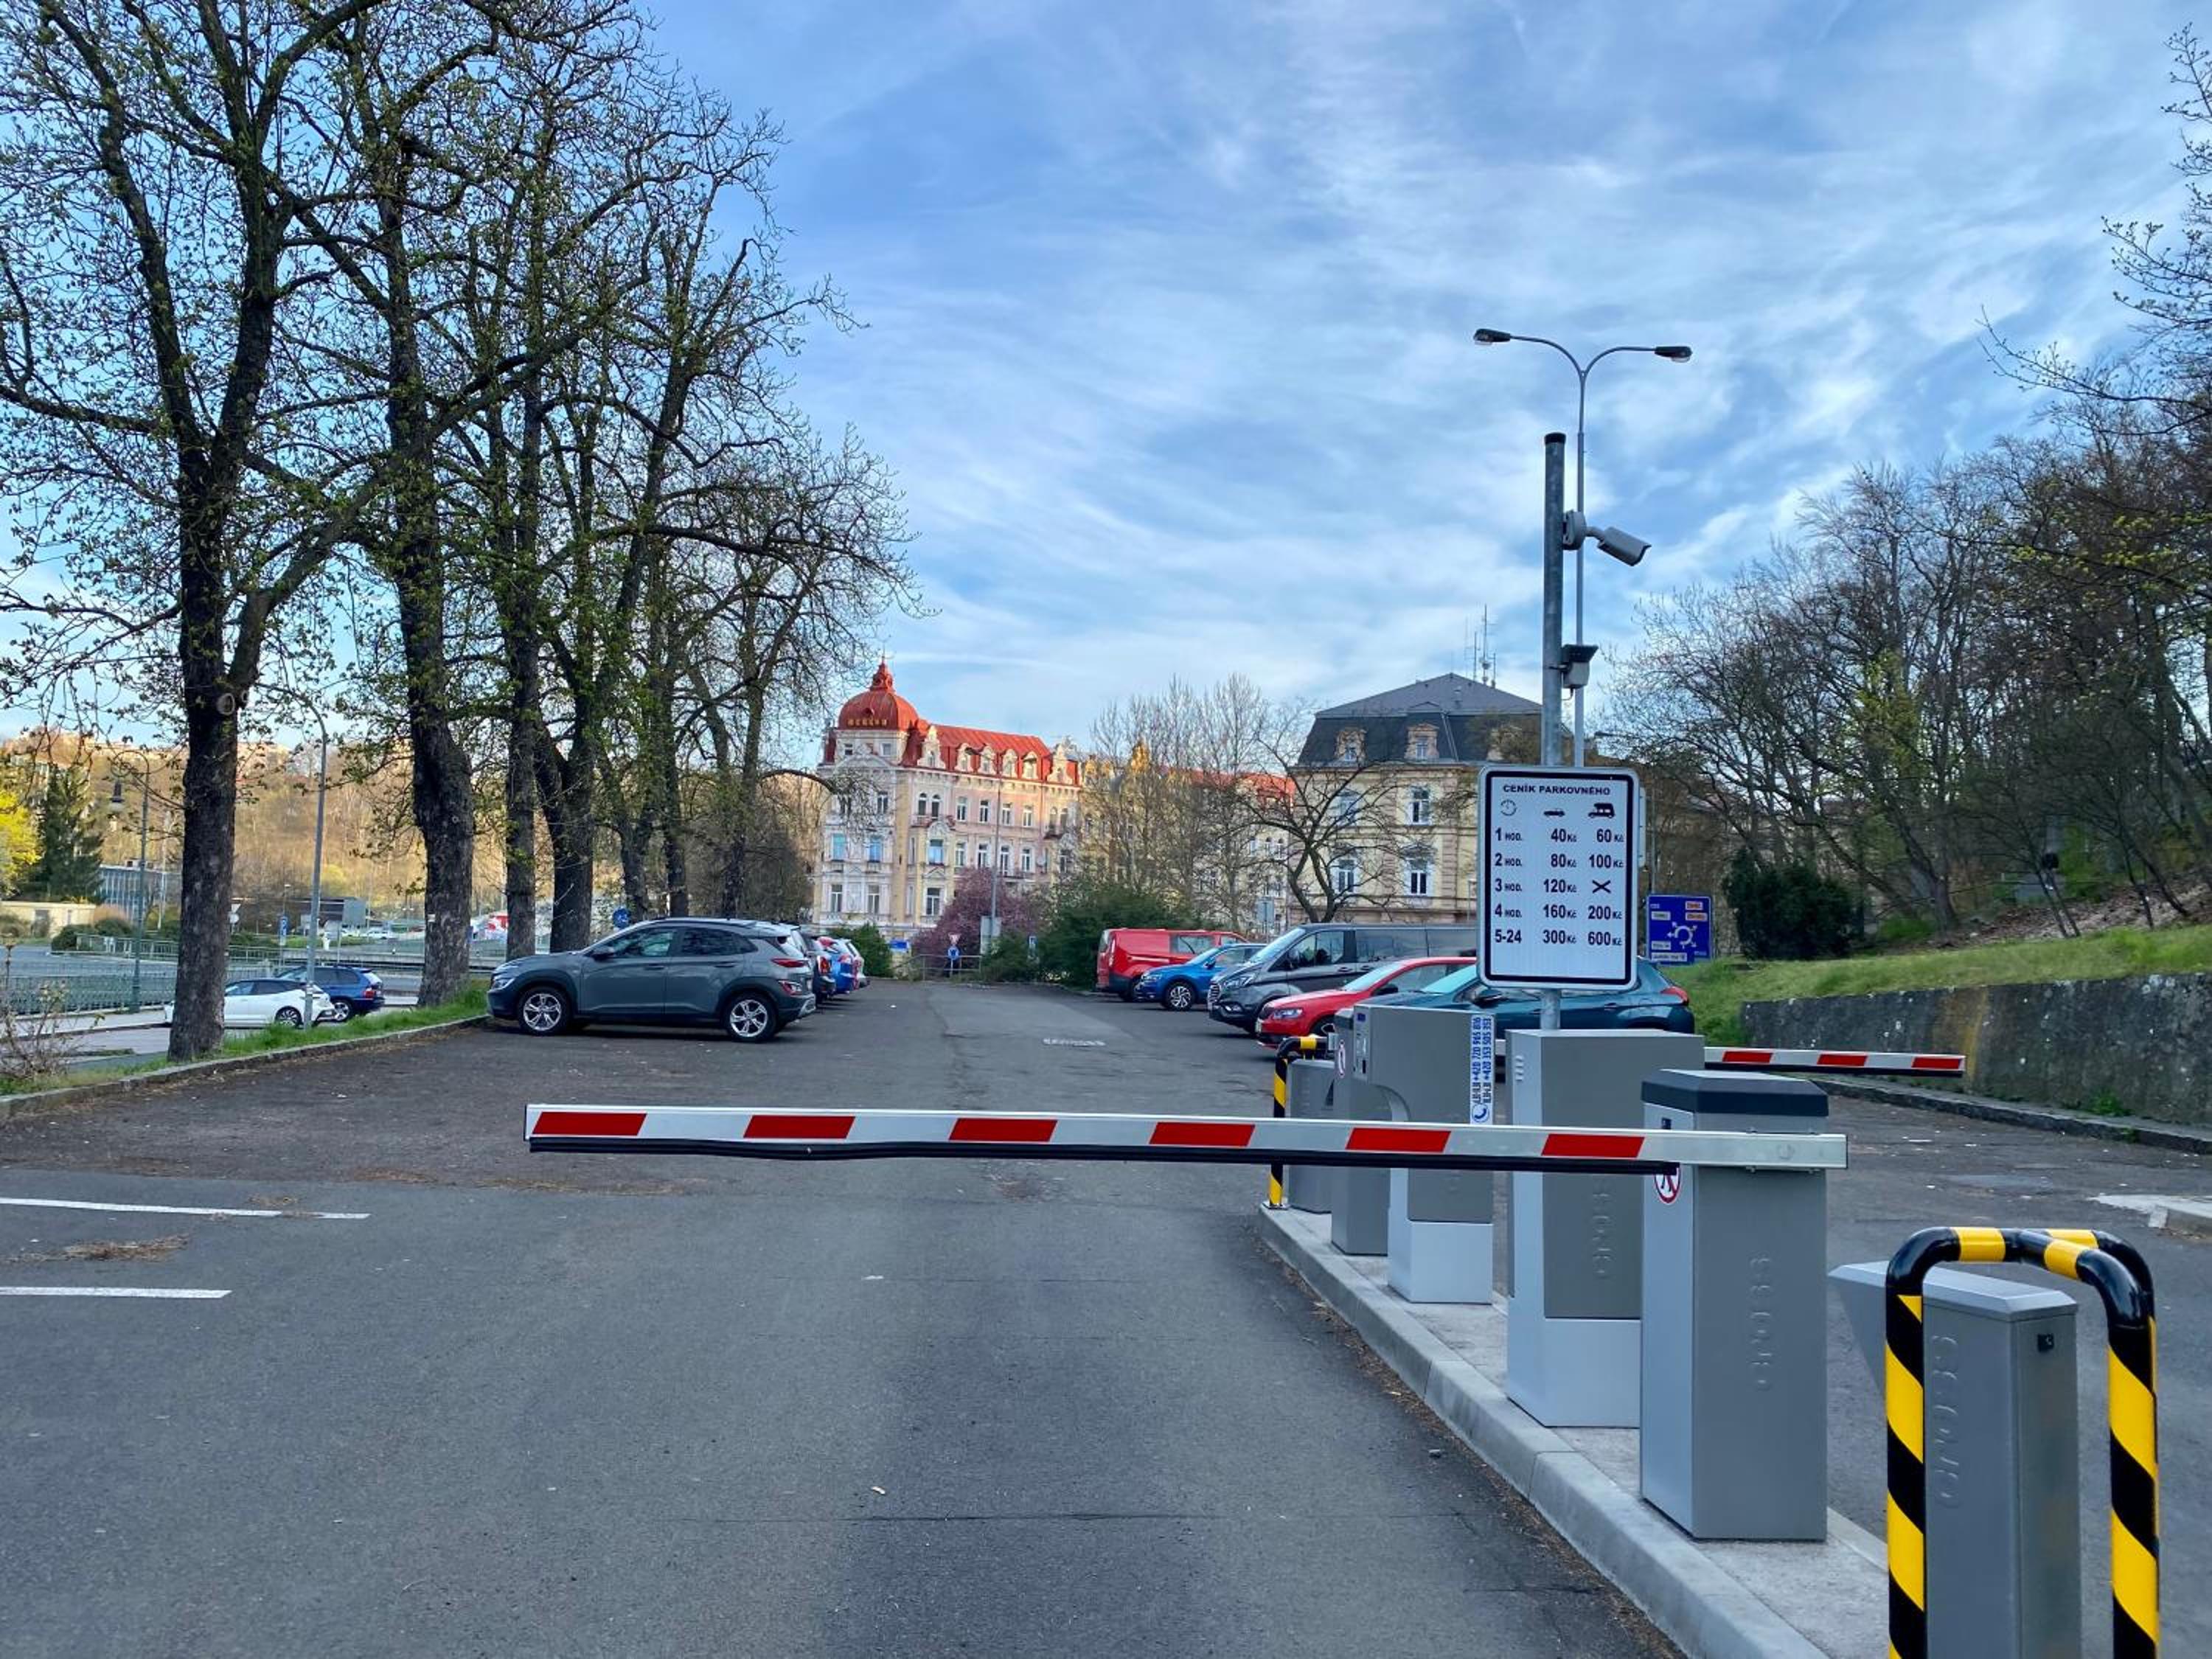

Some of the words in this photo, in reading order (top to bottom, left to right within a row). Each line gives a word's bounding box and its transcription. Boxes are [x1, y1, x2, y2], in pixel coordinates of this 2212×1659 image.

[1503, 784, 1536, 793] CENÍK
[1539, 785, 1611, 796] PARKOVNÉHO
[1495, 827, 1502, 841] 1
[1505, 832, 1523, 841] HOD.
[1495, 852, 1503, 866] 2
[1505, 858, 1523, 866] HOD.
[1495, 877, 1503, 892] 3
[1505, 883, 1523, 891] HOD.
[1495, 903, 1503, 918] 4
[1505, 909, 1523, 917] HOD.
[1495, 928, 1522, 944] 5-24
